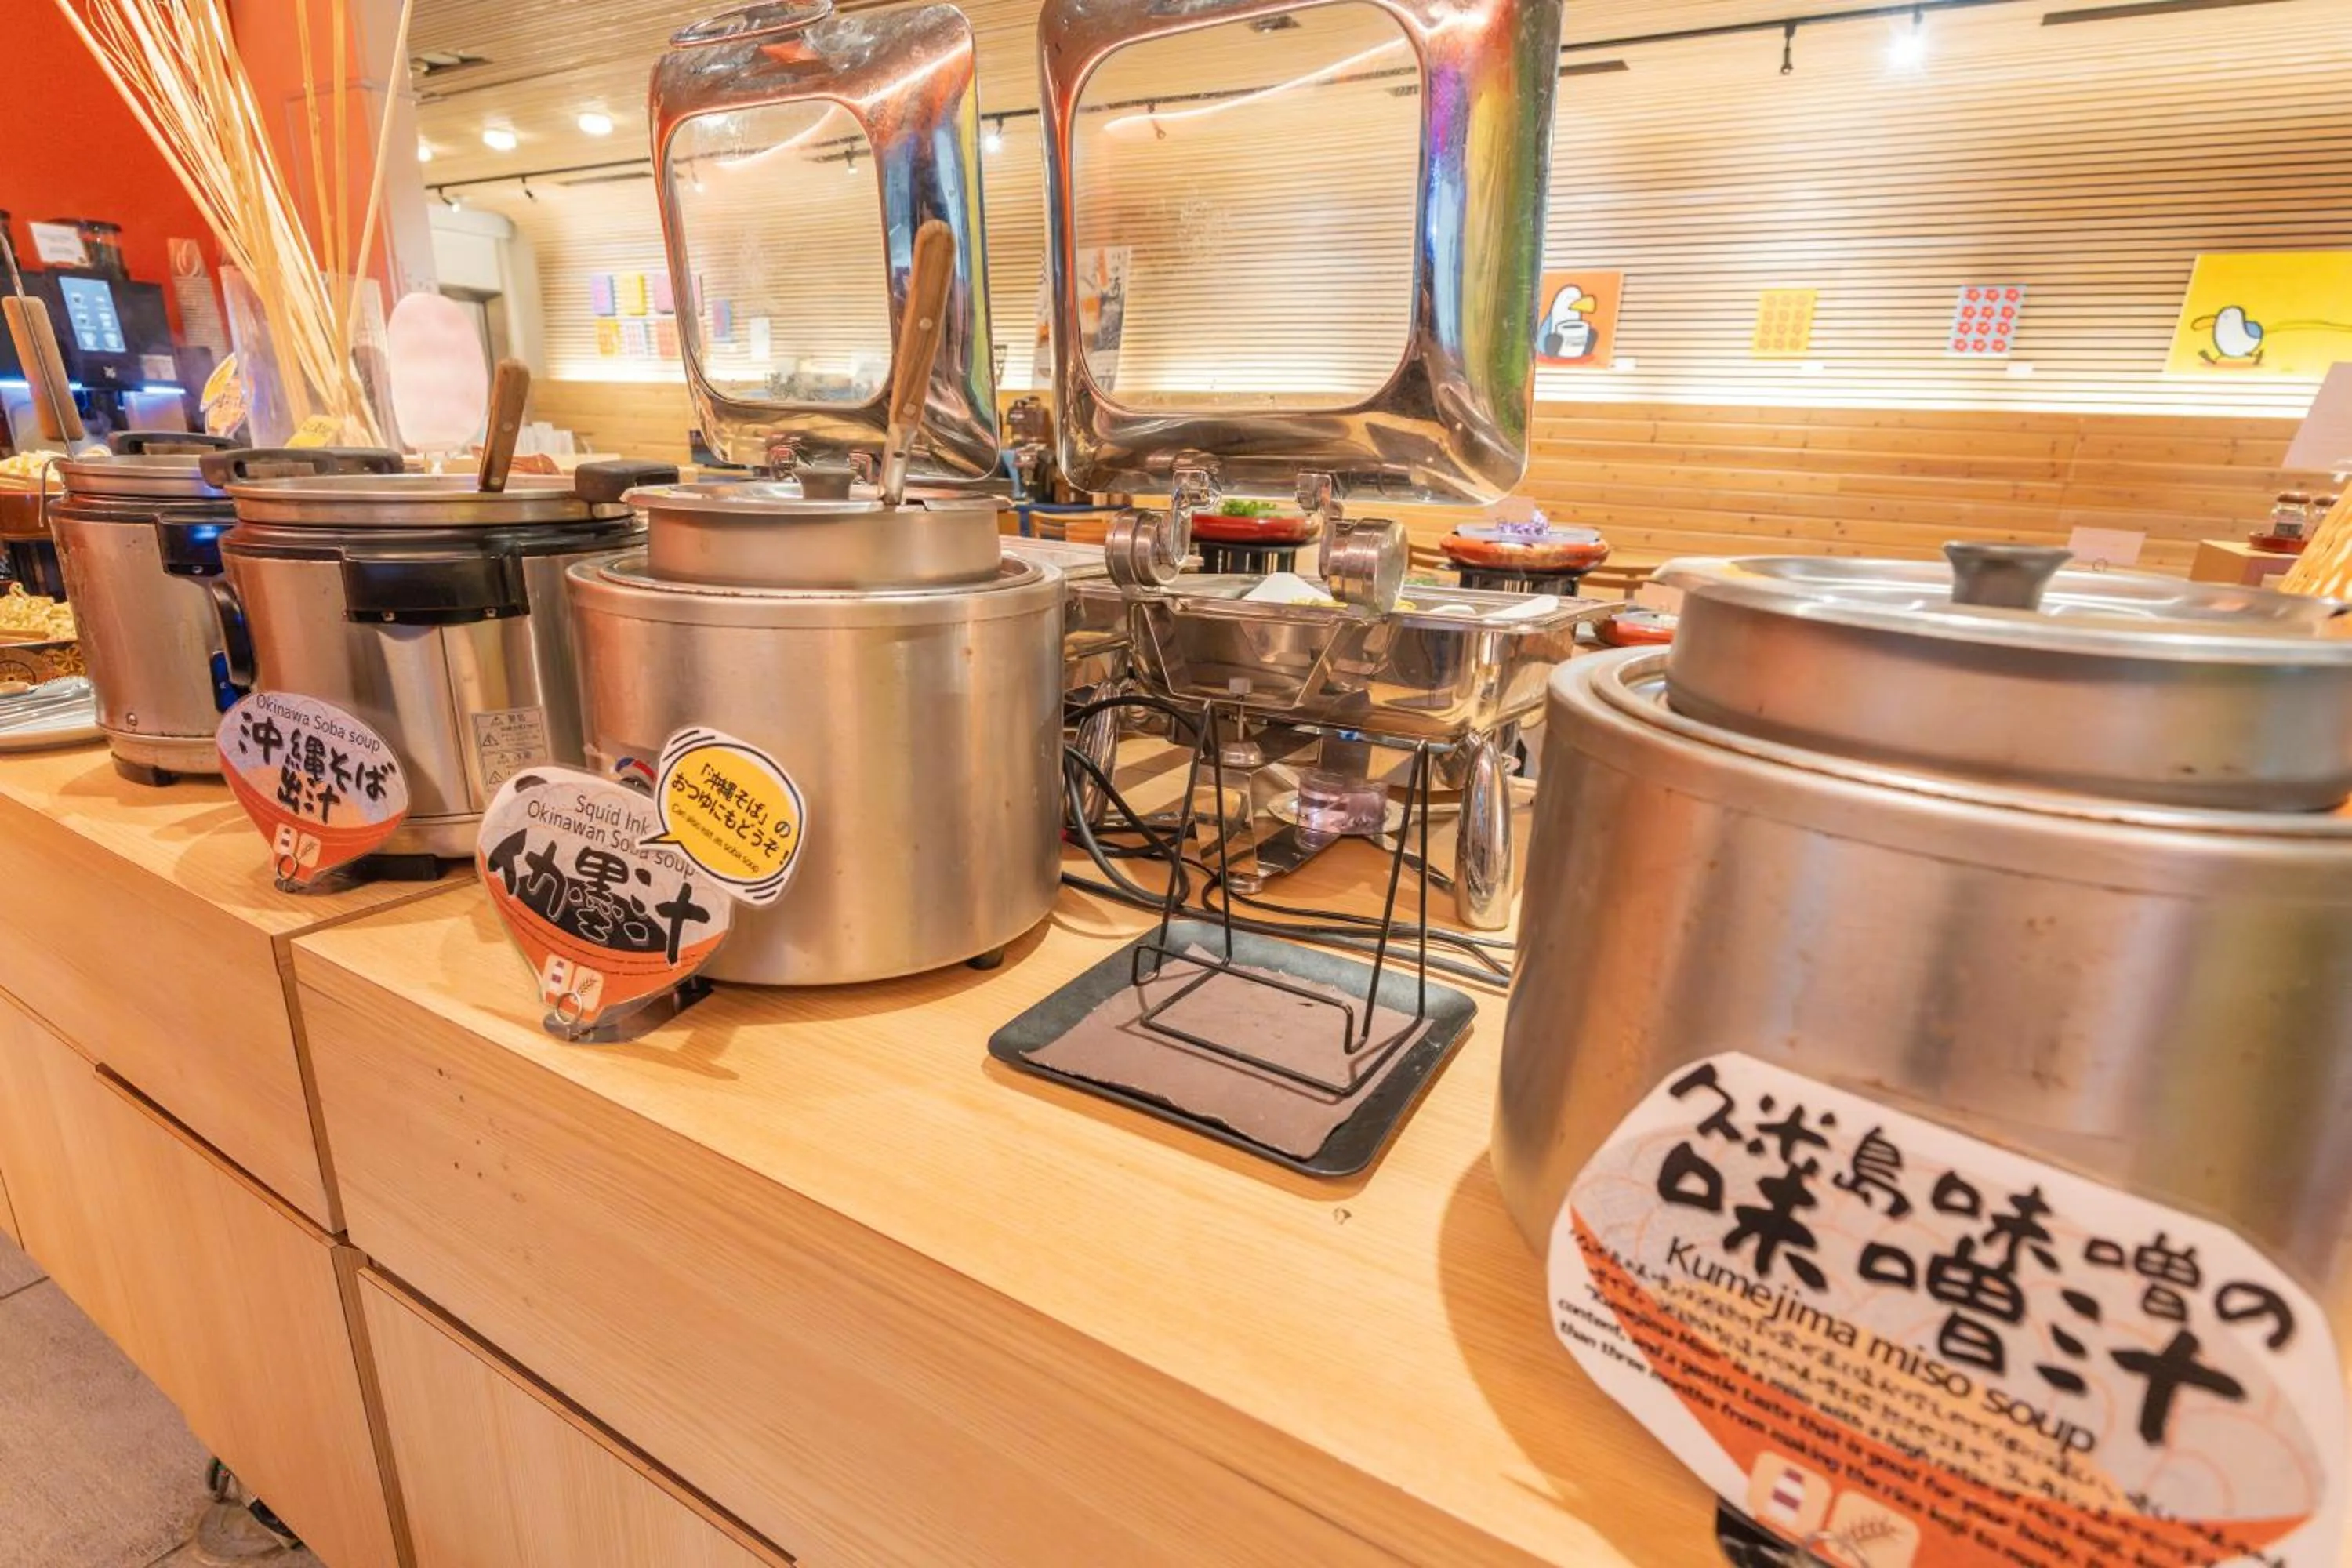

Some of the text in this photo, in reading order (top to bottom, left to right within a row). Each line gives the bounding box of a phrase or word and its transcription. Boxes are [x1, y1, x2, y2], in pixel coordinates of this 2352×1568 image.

[238, 711, 397, 802] 沖縄そば
[256, 693, 381, 753] Okinawa Soba soup
[527, 800, 605, 844] Okinawan
[653, 849, 695, 878] soup
[576, 794, 650, 837] Squid Ink
[488, 827, 710, 966] イカ墨汁
[1668, 1063, 2295, 1352] 久米島味噌の
[1657, 1141, 2247, 1446] 味噌汁
[1559, 1319, 1598, 1348] than
[1721, 1402, 1767, 1432] from
[1667, 1236, 2096, 1455] Kumejima miso soup
[1798, 1414, 1842, 1443] that
